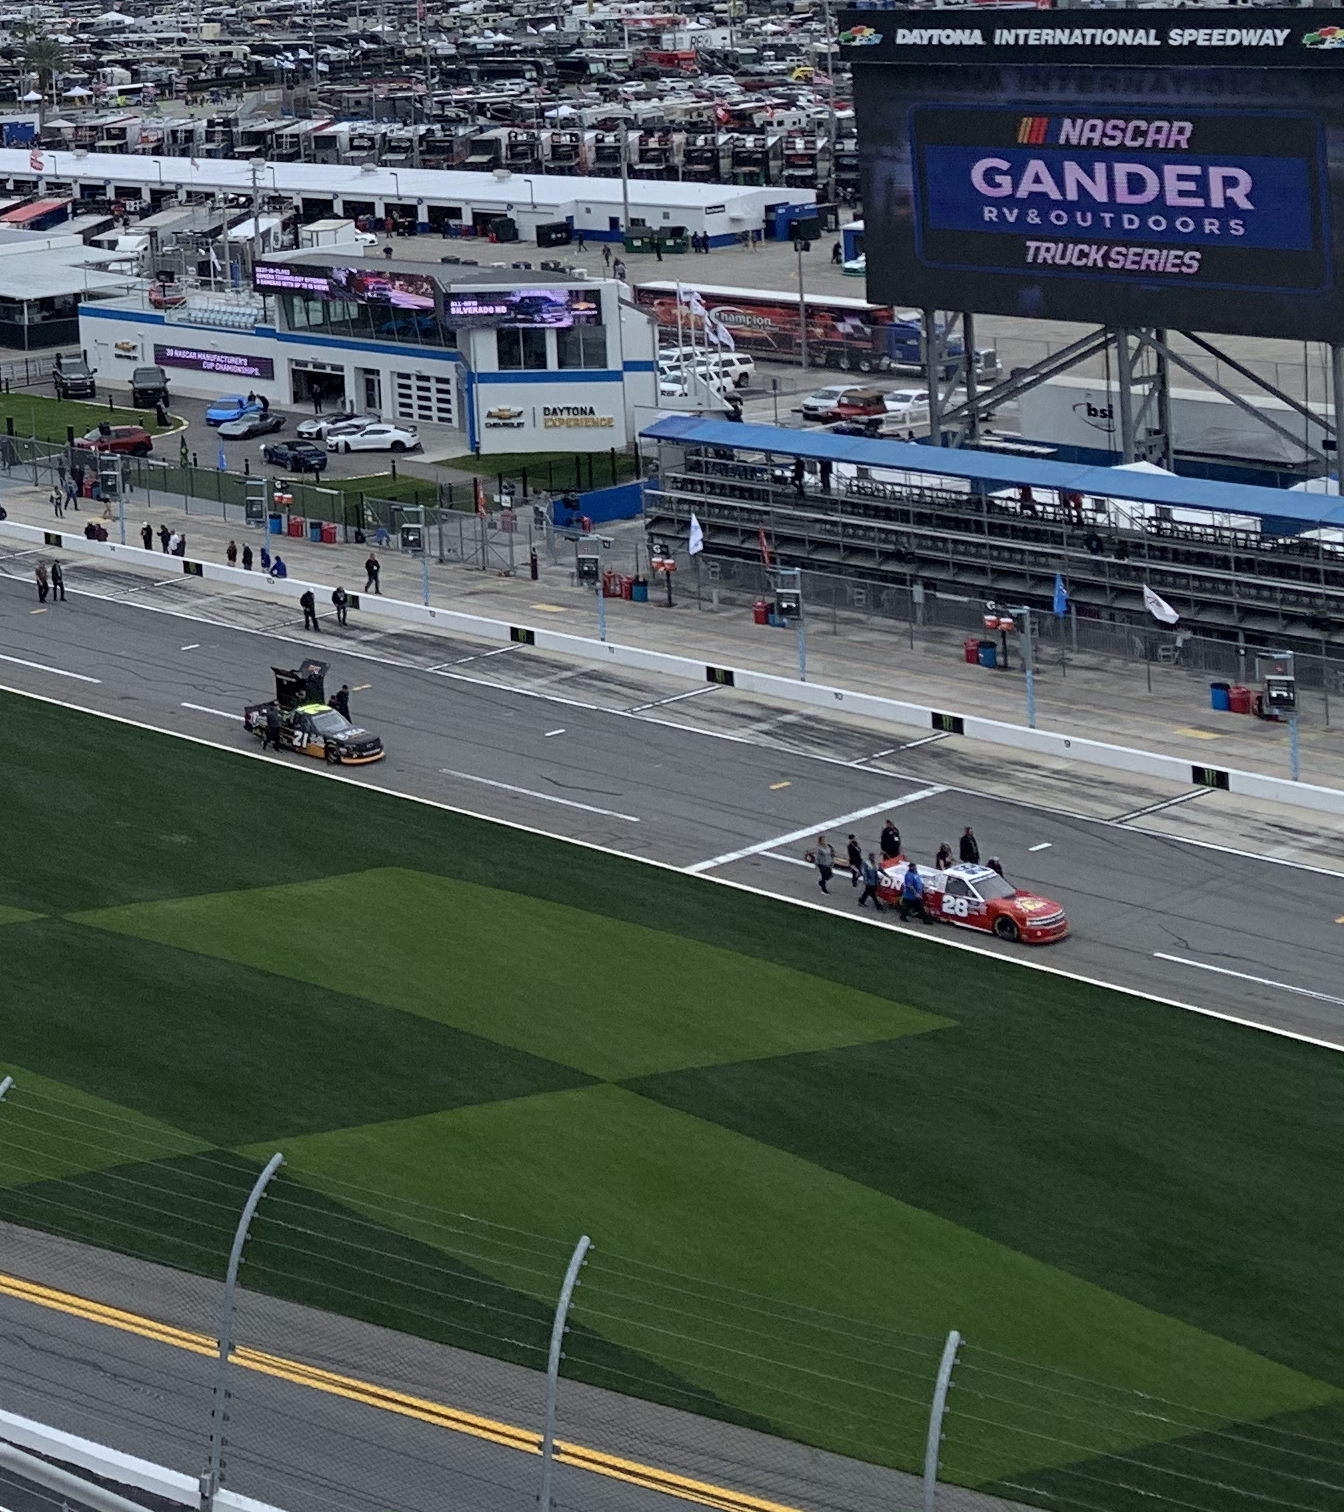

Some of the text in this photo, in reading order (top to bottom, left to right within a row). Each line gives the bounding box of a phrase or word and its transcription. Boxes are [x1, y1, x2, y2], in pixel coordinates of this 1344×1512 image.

[896, 28, 1291, 46] DAYTONA INTERNATIONAL SPEEDWAY
[1059, 117, 1193, 149] NASCAR
[971, 157, 1255, 210] GANDER
[1025, 240, 1202, 274] TRUCK SERIES
[450, 306, 494, 315] SILVERADO
[709, 306, 772, 327] Champion
[543, 406, 595, 416] DAYTONA
[1086, 402, 1113, 419] bsi
[544, 417, 614, 429] EXPERIENCE
[293, 731, 309, 747] 21
[941, 895, 968, 917] 28
